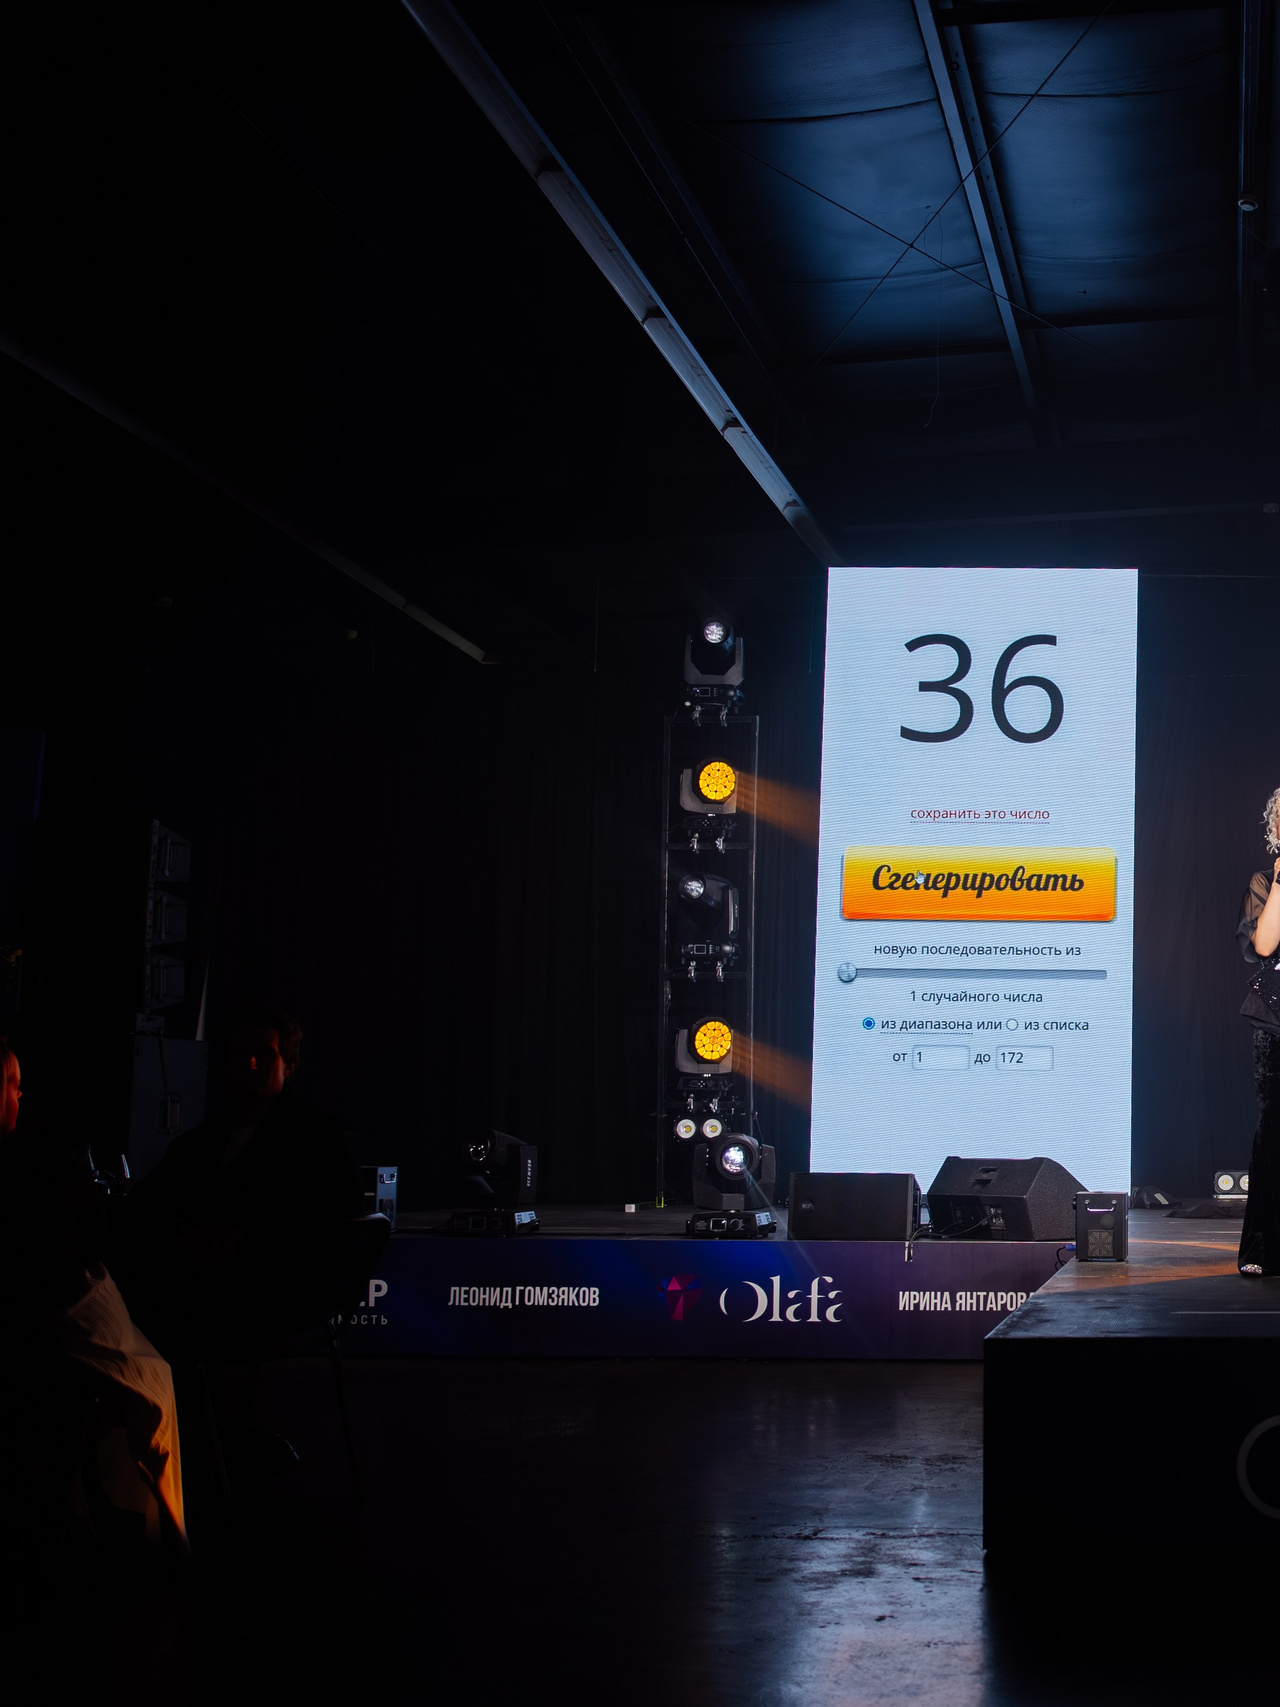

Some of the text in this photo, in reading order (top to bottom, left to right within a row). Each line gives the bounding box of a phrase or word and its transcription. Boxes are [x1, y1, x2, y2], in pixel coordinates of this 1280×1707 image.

[900, 633, 1064, 744] 36
[910, 809, 1050, 821] сохранить это число
[873, 945, 1082, 959] новую последовательность из
[910, 990, 1043, 1006] 1 случайного числа
[881, 1020, 1090, 1031] из диапазона или из списка
[892, 1051, 1024, 1065] от 1 до 172
[448, 1286, 600, 1309] ЛЕОНИД ГОМЗЯКОВ
[898, 1291, 1036, 1312] ИРИНА ЯНТАРОВ
